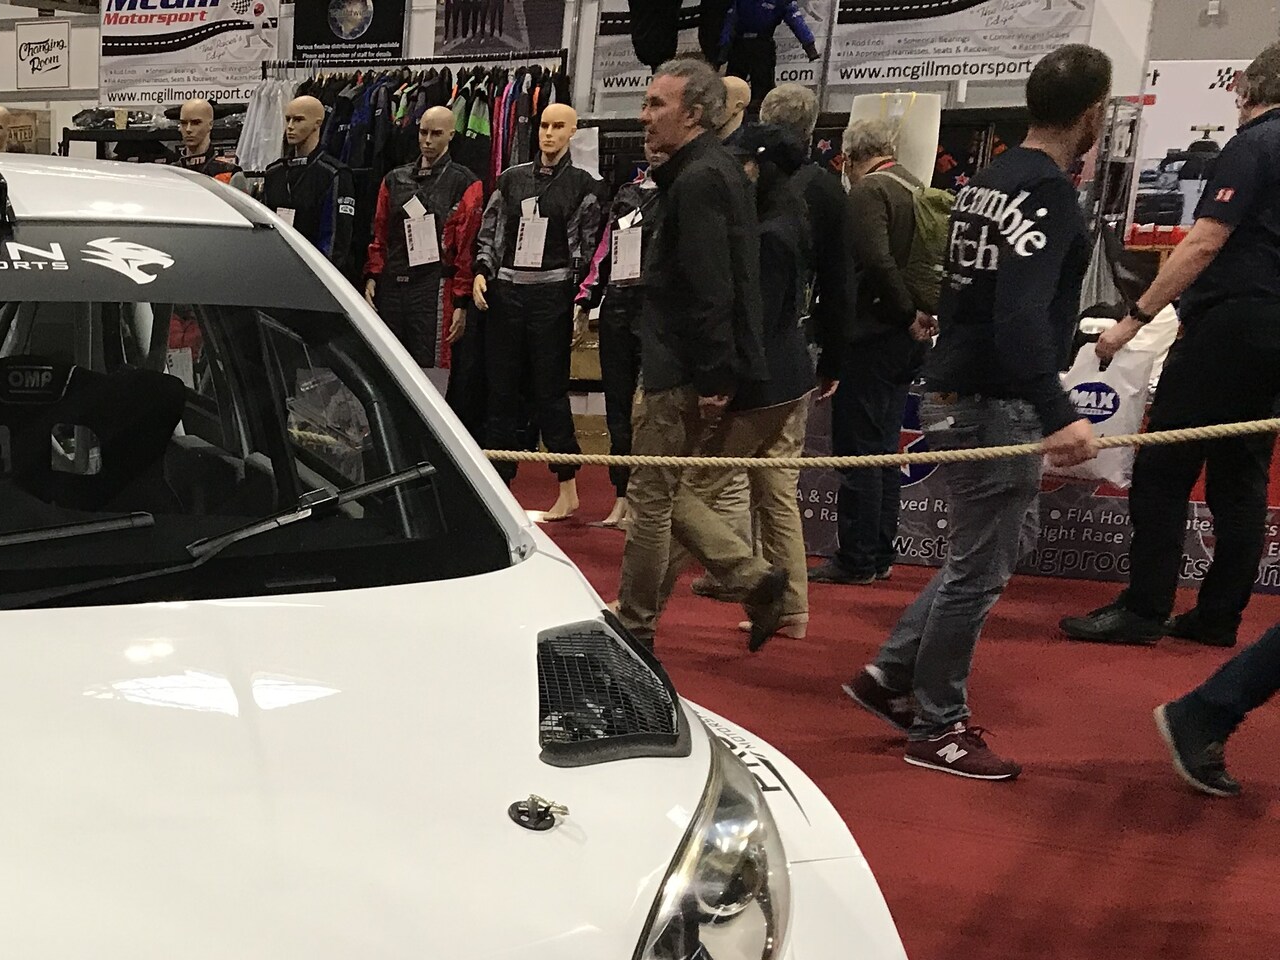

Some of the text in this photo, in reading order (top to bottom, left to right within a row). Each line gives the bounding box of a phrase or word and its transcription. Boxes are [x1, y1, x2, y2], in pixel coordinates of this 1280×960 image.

[103, 10, 208, 26] Motorsport
[18, 37, 67, 62] Changing
[29, 55, 60, 75] Room
[8, 371, 52, 388] OMP
[900, 497, 928, 512] ved
[1067, 508, 1094, 523] FIA
[1081, 526, 1124, 545] Race
[936, 742, 968, 764] N
